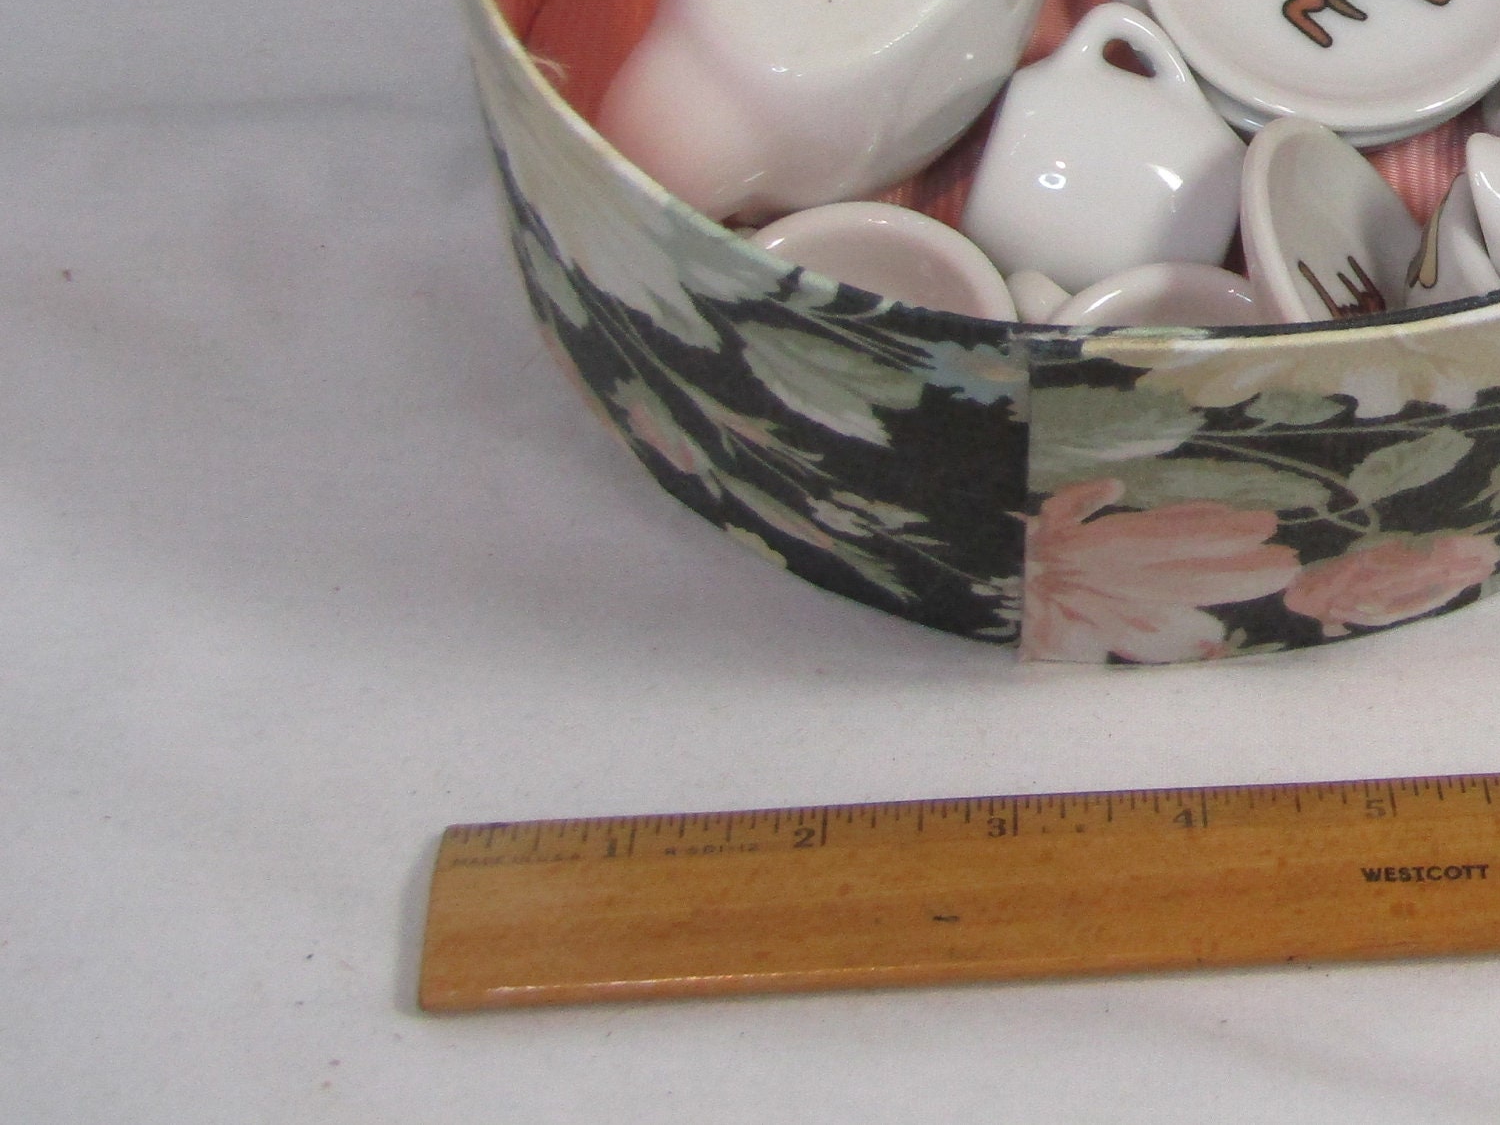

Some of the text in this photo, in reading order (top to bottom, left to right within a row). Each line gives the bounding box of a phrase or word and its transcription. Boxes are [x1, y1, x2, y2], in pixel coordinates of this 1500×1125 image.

[793, 827, 816, 849] 2
[986, 817, 1007, 837] 3
[1173, 808, 1195, 828] 4
[1366, 798, 1387, 819] 5
[1361, 864, 1490, 883] WESTCOTT
